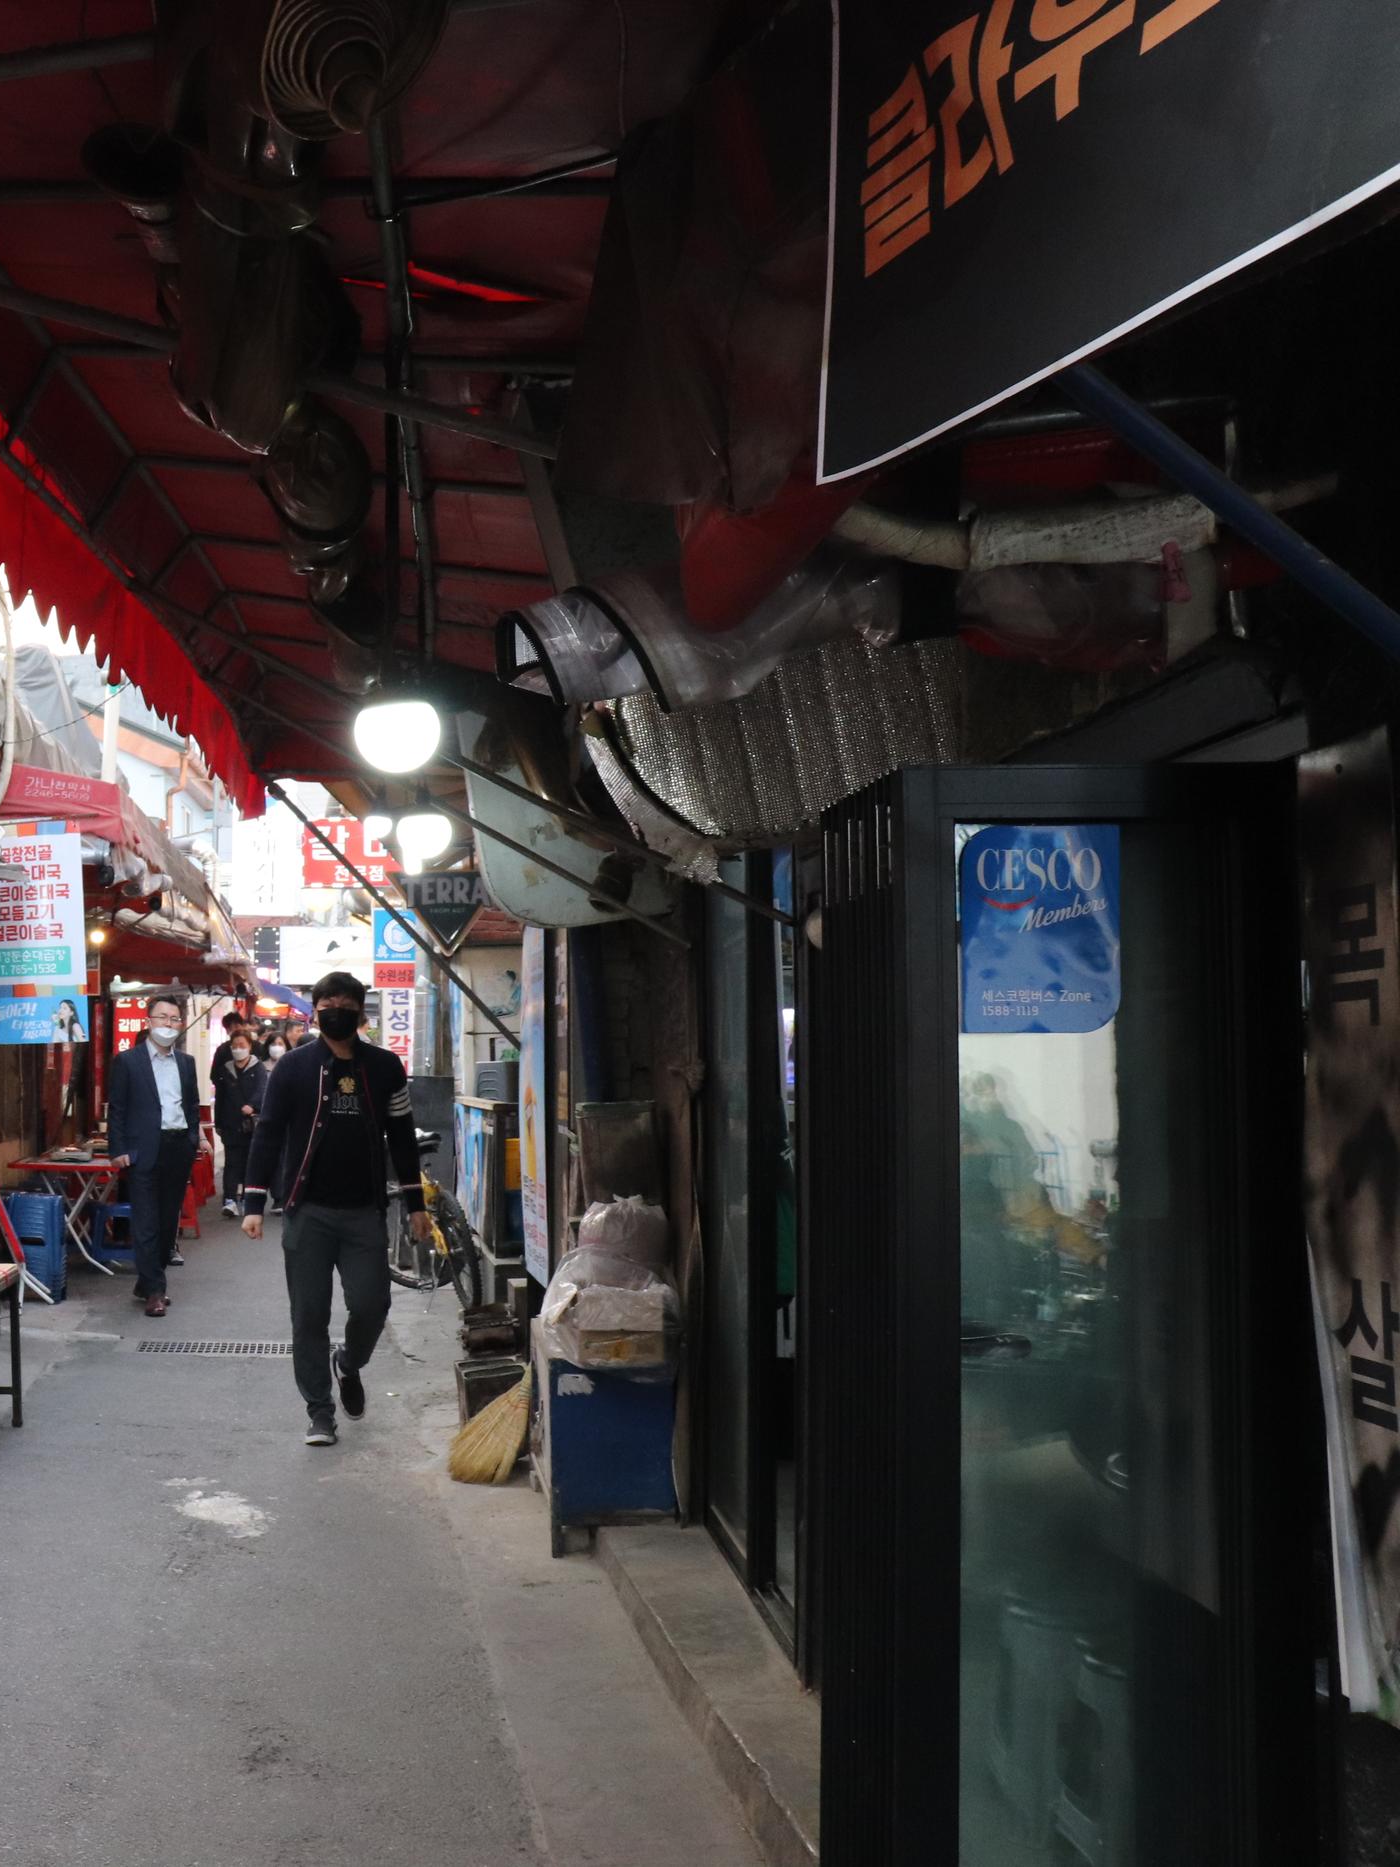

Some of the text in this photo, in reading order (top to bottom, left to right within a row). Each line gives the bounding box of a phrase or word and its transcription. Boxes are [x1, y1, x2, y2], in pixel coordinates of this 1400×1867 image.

[977, 848, 1102, 892] CESCO
[1018, 894, 1108, 933] Members
[983, 989, 1091, 1002] 세스코멤버스 Zone
